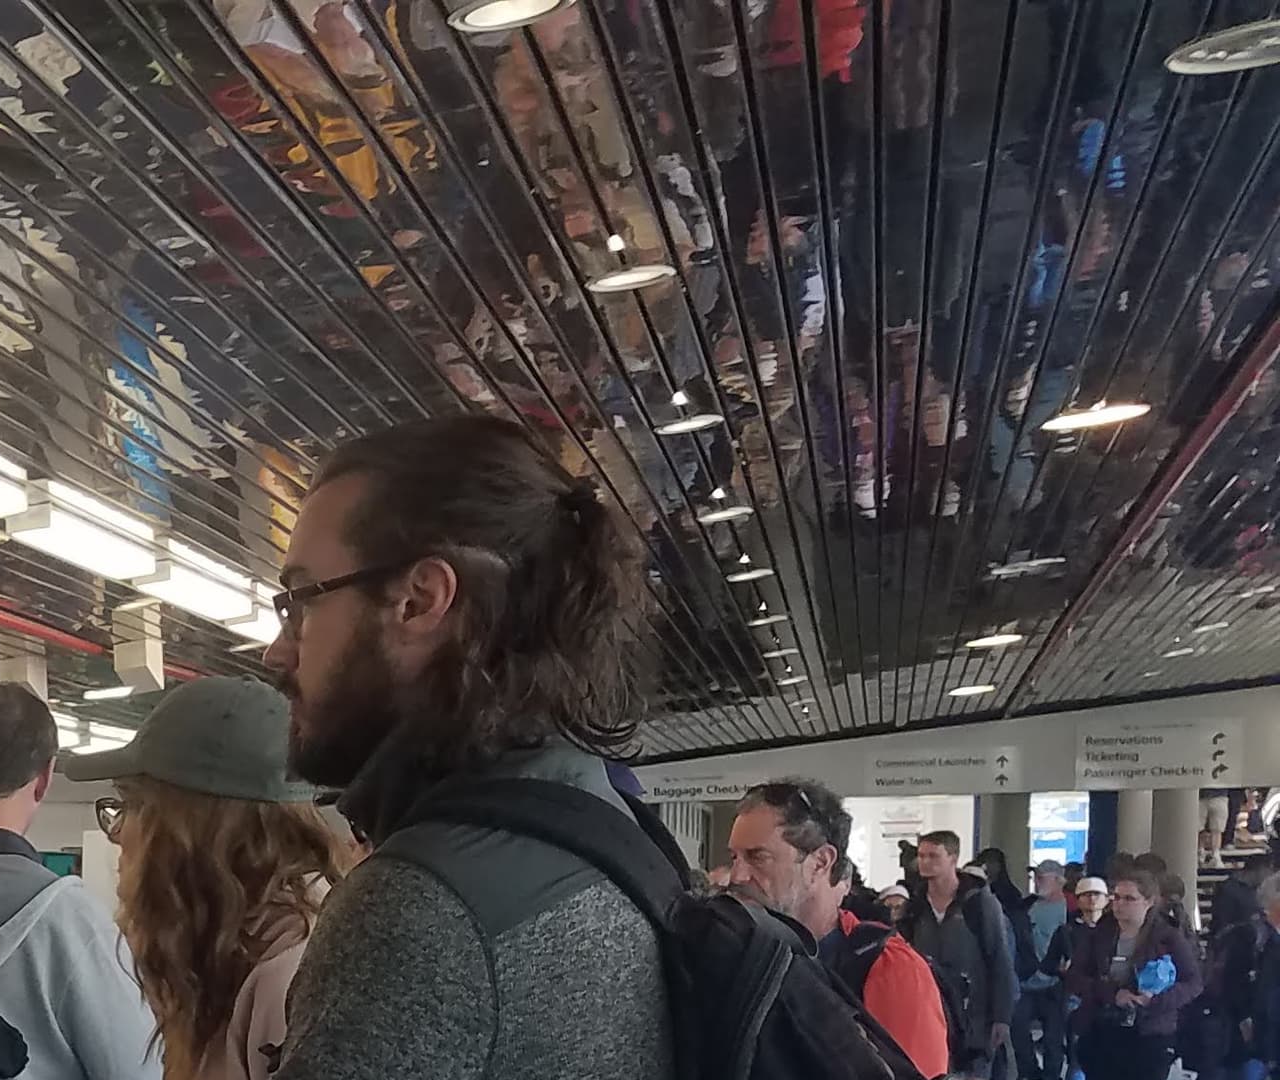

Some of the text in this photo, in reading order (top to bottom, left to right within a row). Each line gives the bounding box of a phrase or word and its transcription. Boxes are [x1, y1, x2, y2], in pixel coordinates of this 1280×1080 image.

[1085, 735, 1163, 746] Reservations
[1085, 751, 1139, 763] Ticketing
[1084, 767, 1146, 779] Passenger
[653, 786, 703, 798] Baggage
